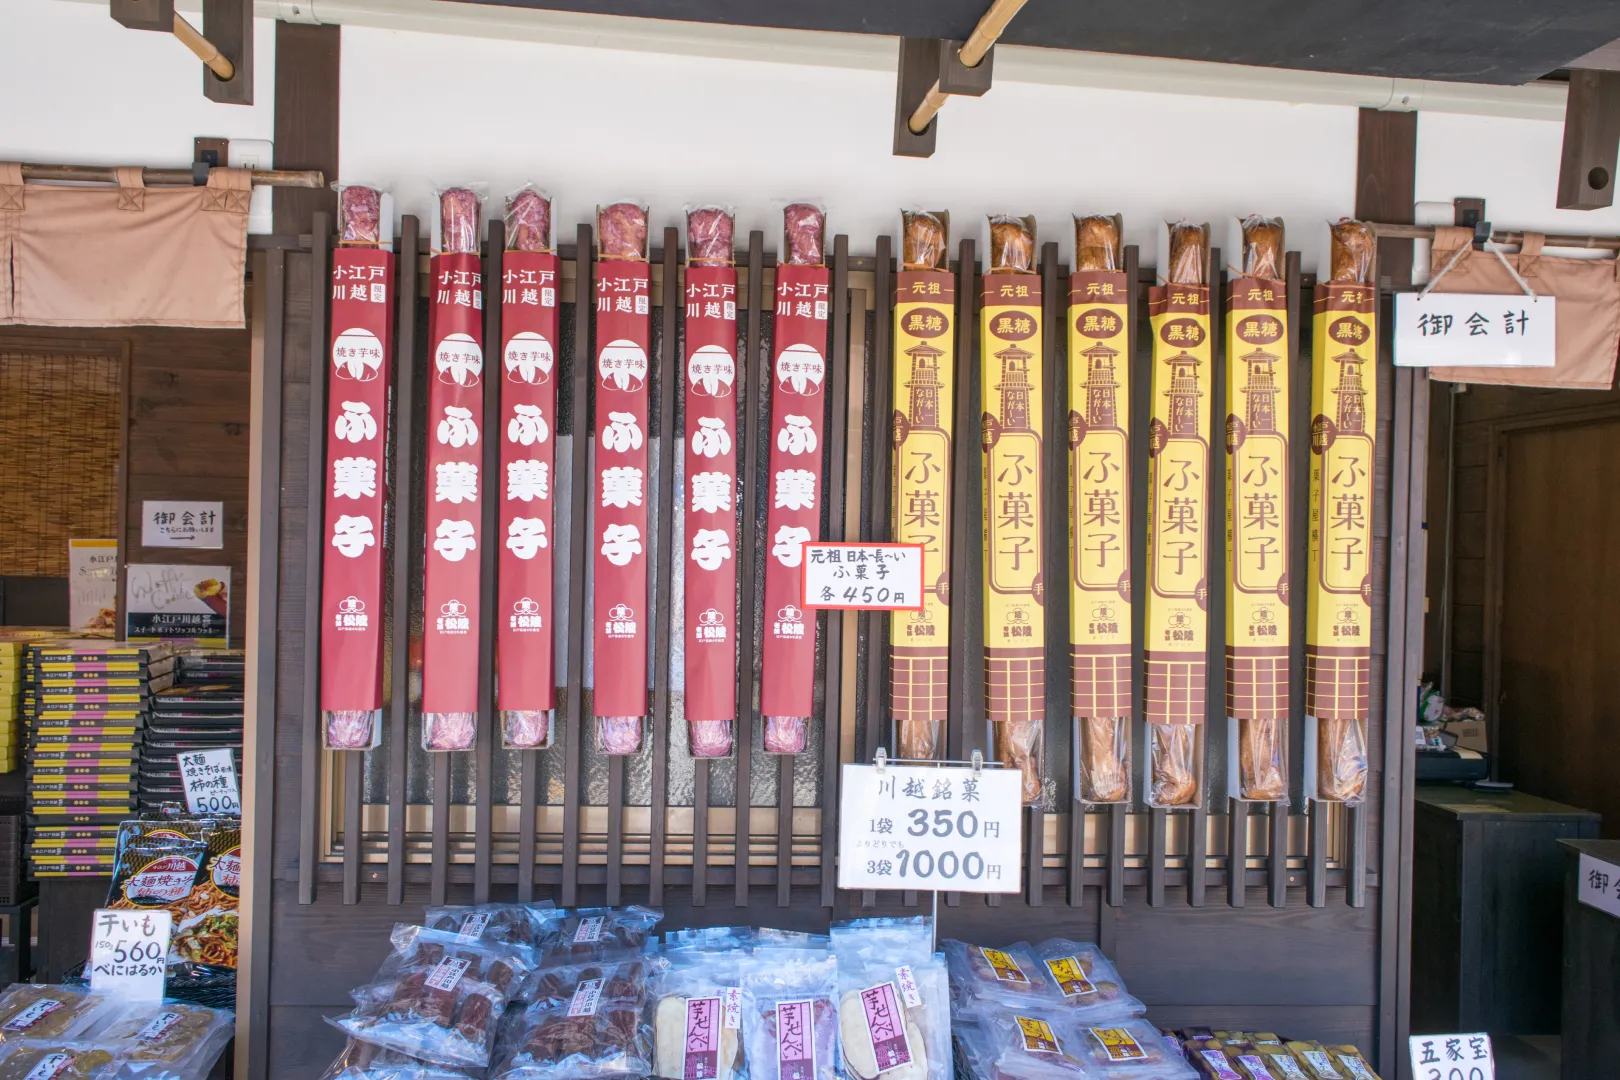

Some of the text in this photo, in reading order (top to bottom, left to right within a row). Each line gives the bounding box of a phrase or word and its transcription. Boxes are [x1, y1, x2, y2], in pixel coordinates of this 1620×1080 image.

[333, 265, 385, 281] 小江戸
[438, 269, 481, 287] 小江戸
[503, 269, 555, 286] 小江戸
[333, 284, 368, 301] 川越
[597, 277, 648, 293] 小江戸
[686, 283, 735, 298] 小江戸
[777, 282, 828, 299] 小江戸
[912, 282, 941, 294] 元祖
[1000, 285, 1029, 297] 元祖
[1086, 283, 1115, 295] 元祖
[437, 288, 471, 307] 川越
[503, 288, 538, 305] 川越
[1172, 293, 1199, 305] 元祖
[1248, 289, 1274, 301] 元祖
[597, 296, 632, 313] 川越
[686, 301, 721, 318] 川越
[776, 301, 812, 318] 川越
[908, 315, 942, 331] 黒糖
[997, 317, 1031, 334] 黒糖
[1083, 316, 1117, 332] 黒糖
[1243, 322, 1278, 337] 黒糖
[1337, 323, 1362, 340] 黒糖
[1417, 310, 1529, 336] 御会計
[1168, 325, 1200, 341] 黒糖
[336, 347, 380, 358] 焼き芋味
[439, 352, 481, 364] 焼き芋味
[508, 351, 551, 362] 焼き芋味
[602, 358, 645, 369] 焼き芋味
[691, 364, 733, 375] 焼き芋味
[780, 362, 822, 374] 焼き芋味
[925, 389, 934, 417] 日本一
[1016, 391, 1025, 419] 日本一
[1102, 389, 1111, 416] 日本一
[1185, 398, 1194, 424] 日本一
[1262, 395, 1271, 421] 日本一
[1353, 395, 1361, 422] 日本一
[332, 400, 377, 558] ふ菓子
[433, 405, 479, 562] ふ菓子
[506, 404, 549, 560] ふ菓子
[601, 411, 643, 566] ふ菓子
[691, 416, 731, 571] ふ菓子
[772, 414, 817, 568] ふ菓子
[153, 510, 216, 525] 御会計
[997, 454, 1034, 571] ふ菓子
[1083, 451, 1121, 568] ふ菓子
[1162, 459, 1200, 575] ふ菓子
[1243, 456, 1279, 571] ふ菓子
[1331, 456, 1366, 571] ふ菓子
[811, 549, 841, 563] 元祖
[833, 564, 890, 580] ふ菓子
[820, 586, 904, 604] 各 450円
[183, 754, 206, 767] 太麺
[190, 775, 228, 792] 柿の種
[878, 775, 980, 802] 川越銘菓
[197, 795, 239, 813] 500円
[869, 808, 1000, 838] 1袋 350円
[867, 849, 1001, 880] 3袋 1000円
[98, 914, 156, 937] 干いも
[114, 940, 165, 964] 560円
[94, 964, 163, 977] べにはるか
[897, 967, 916, 1004] 素焼き
[726, 988, 741, 1026] 素焼き
[865, 989, 893, 1041] 芋せんべい
[688, 1000, 710, 1052] 芋せんべい
[781, 1005, 803, 1059] 芋せんべい
[1420, 1036, 1488, 1065] 五家宝
